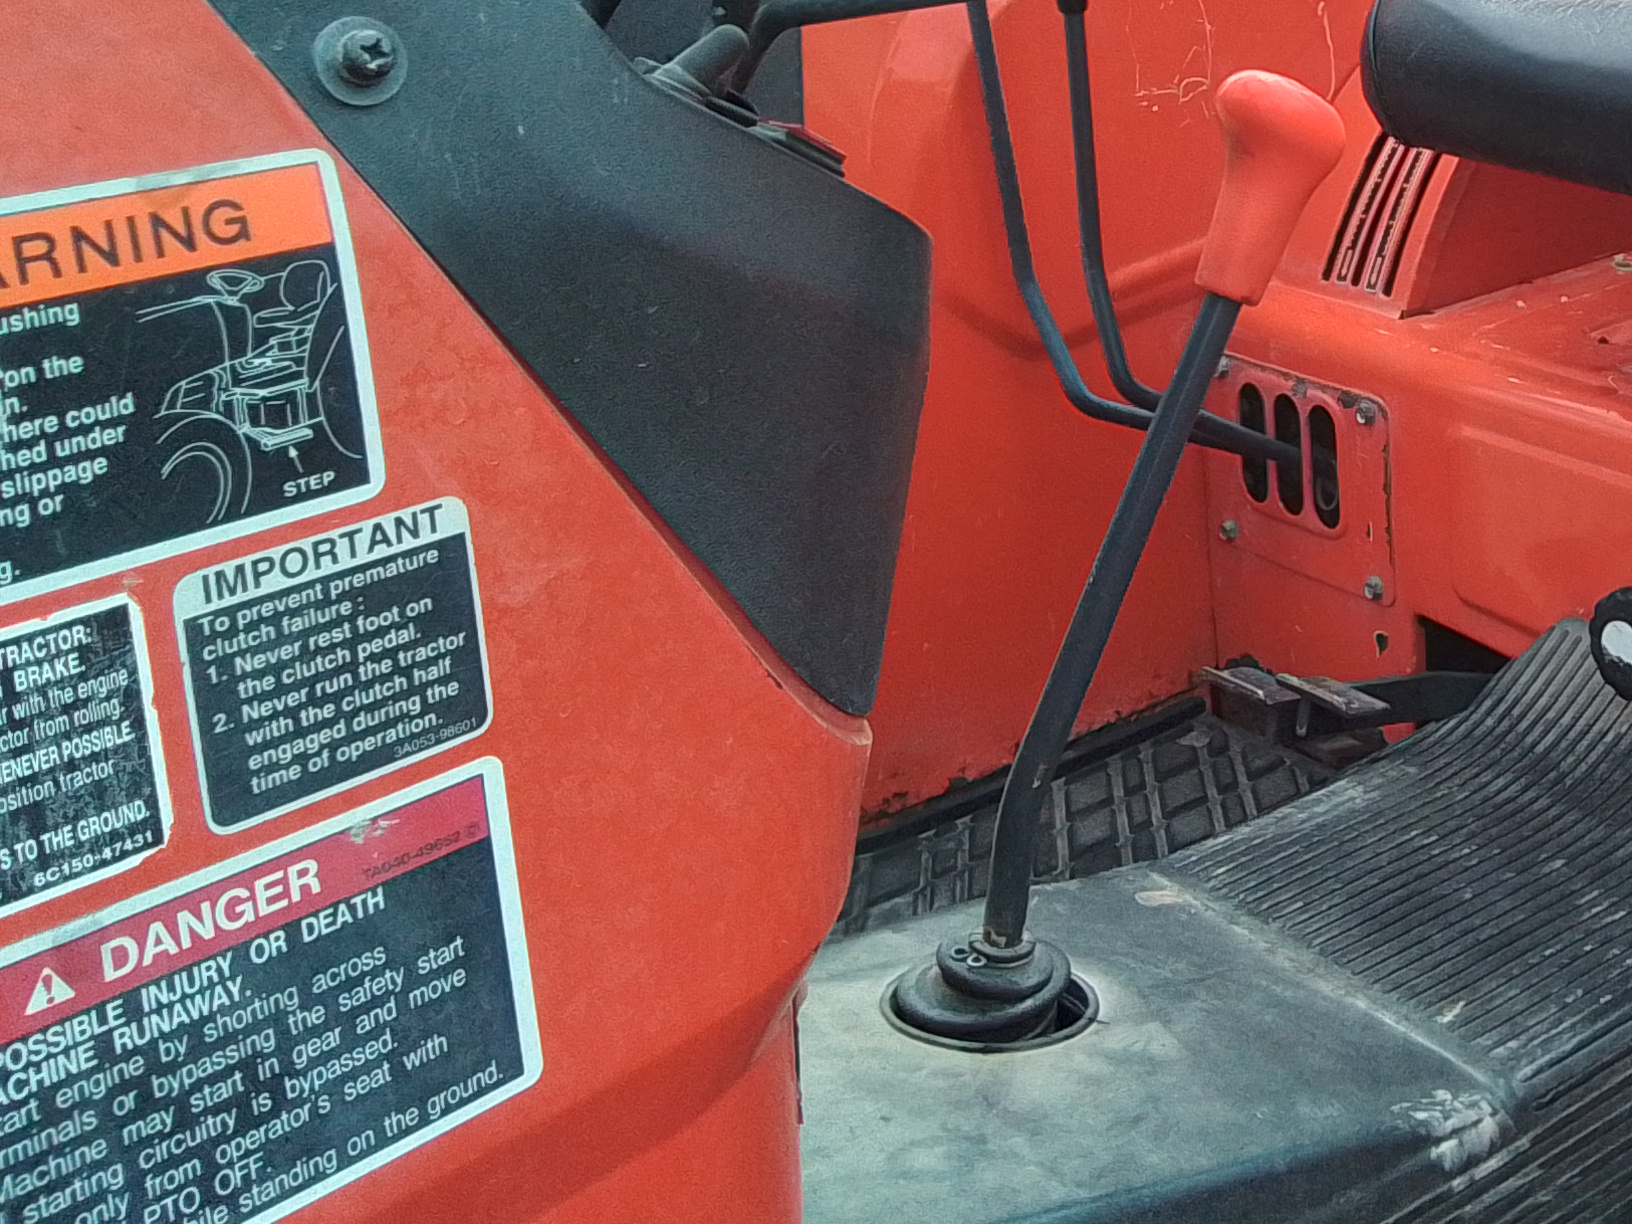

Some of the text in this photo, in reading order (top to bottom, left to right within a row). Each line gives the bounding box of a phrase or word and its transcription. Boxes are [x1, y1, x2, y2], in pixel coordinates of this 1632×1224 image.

[0, 199, 251, 288] RNING
[42, 356, 84, 378] the
[54, 426, 125, 456] under
[65, 393, 134, 427] could
[0, 457, 108, 498] slippage
[38, 494, 63, 515] or
[282, 471, 335, 497] STEP
[198, 549, 439, 636] To prevent premature
[201, 504, 443, 604] IMPORTANT
[203, 621, 276, 660] clutch
[282, 599, 352, 635] failure
[206, 597, 433, 684] 1. Never rest foot on
[237, 622, 421, 699] the clutch pedal.
[12, 693, 46, 720] with
[48, 687, 74, 708] the
[78, 669, 129, 699] engine
[14, 653, 85, 692] BRAKE.
[212, 631, 467, 734] 2. Never run the tractor
[245, 656, 453, 746] with the clutch half
[0, 746, 60, 784] ENEVER
[34, 715, 69, 741] from
[248, 681, 459, 770] engaged during the
[250, 712, 443, 794] time of operation.
[60, 758, 116, 792] tractor
[13, 839, 38, 863] TO
[40, 825, 75, 854] THE
[77, 800, 150, 837] GROUND.
[34, 830, 153, 886] 6C150-47431
[100, 859, 321, 982] DANGER
[0, 886, 385, 1071] OSSIBLE INJURY OR DEATH
[112, 974, 252, 1055] RUNAWAY.
[0, 946, 386, 1135] art engine by shorting across
[113, 1090, 139, 1116] or
[151, 1027, 274, 1098] bypassing
[288, 1005, 325, 1036] the
[339, 967, 404, 1012] safety
[417, 935, 465, 975] start
[122, 1105, 175, 1146] may
[189, 1070, 245, 1113] start
[257, 1057, 279, 1082] in
[292, 1026, 342, 1069] gear
[356, 996, 397, 1034] and
[408, 968, 467, 1009] move
[22, 1028, 398, 1224] starting circuitry is bypassed.
[75, 1033, 448, 1224] only from operator's seat with
[240, 1147, 338, 1213] standing
[347, 1129, 375, 1156] on
[383, 1105, 419, 1137] the
[427, 1060, 503, 1119] ground.
[143, 1151, 272, 1224] PTO OFF.
